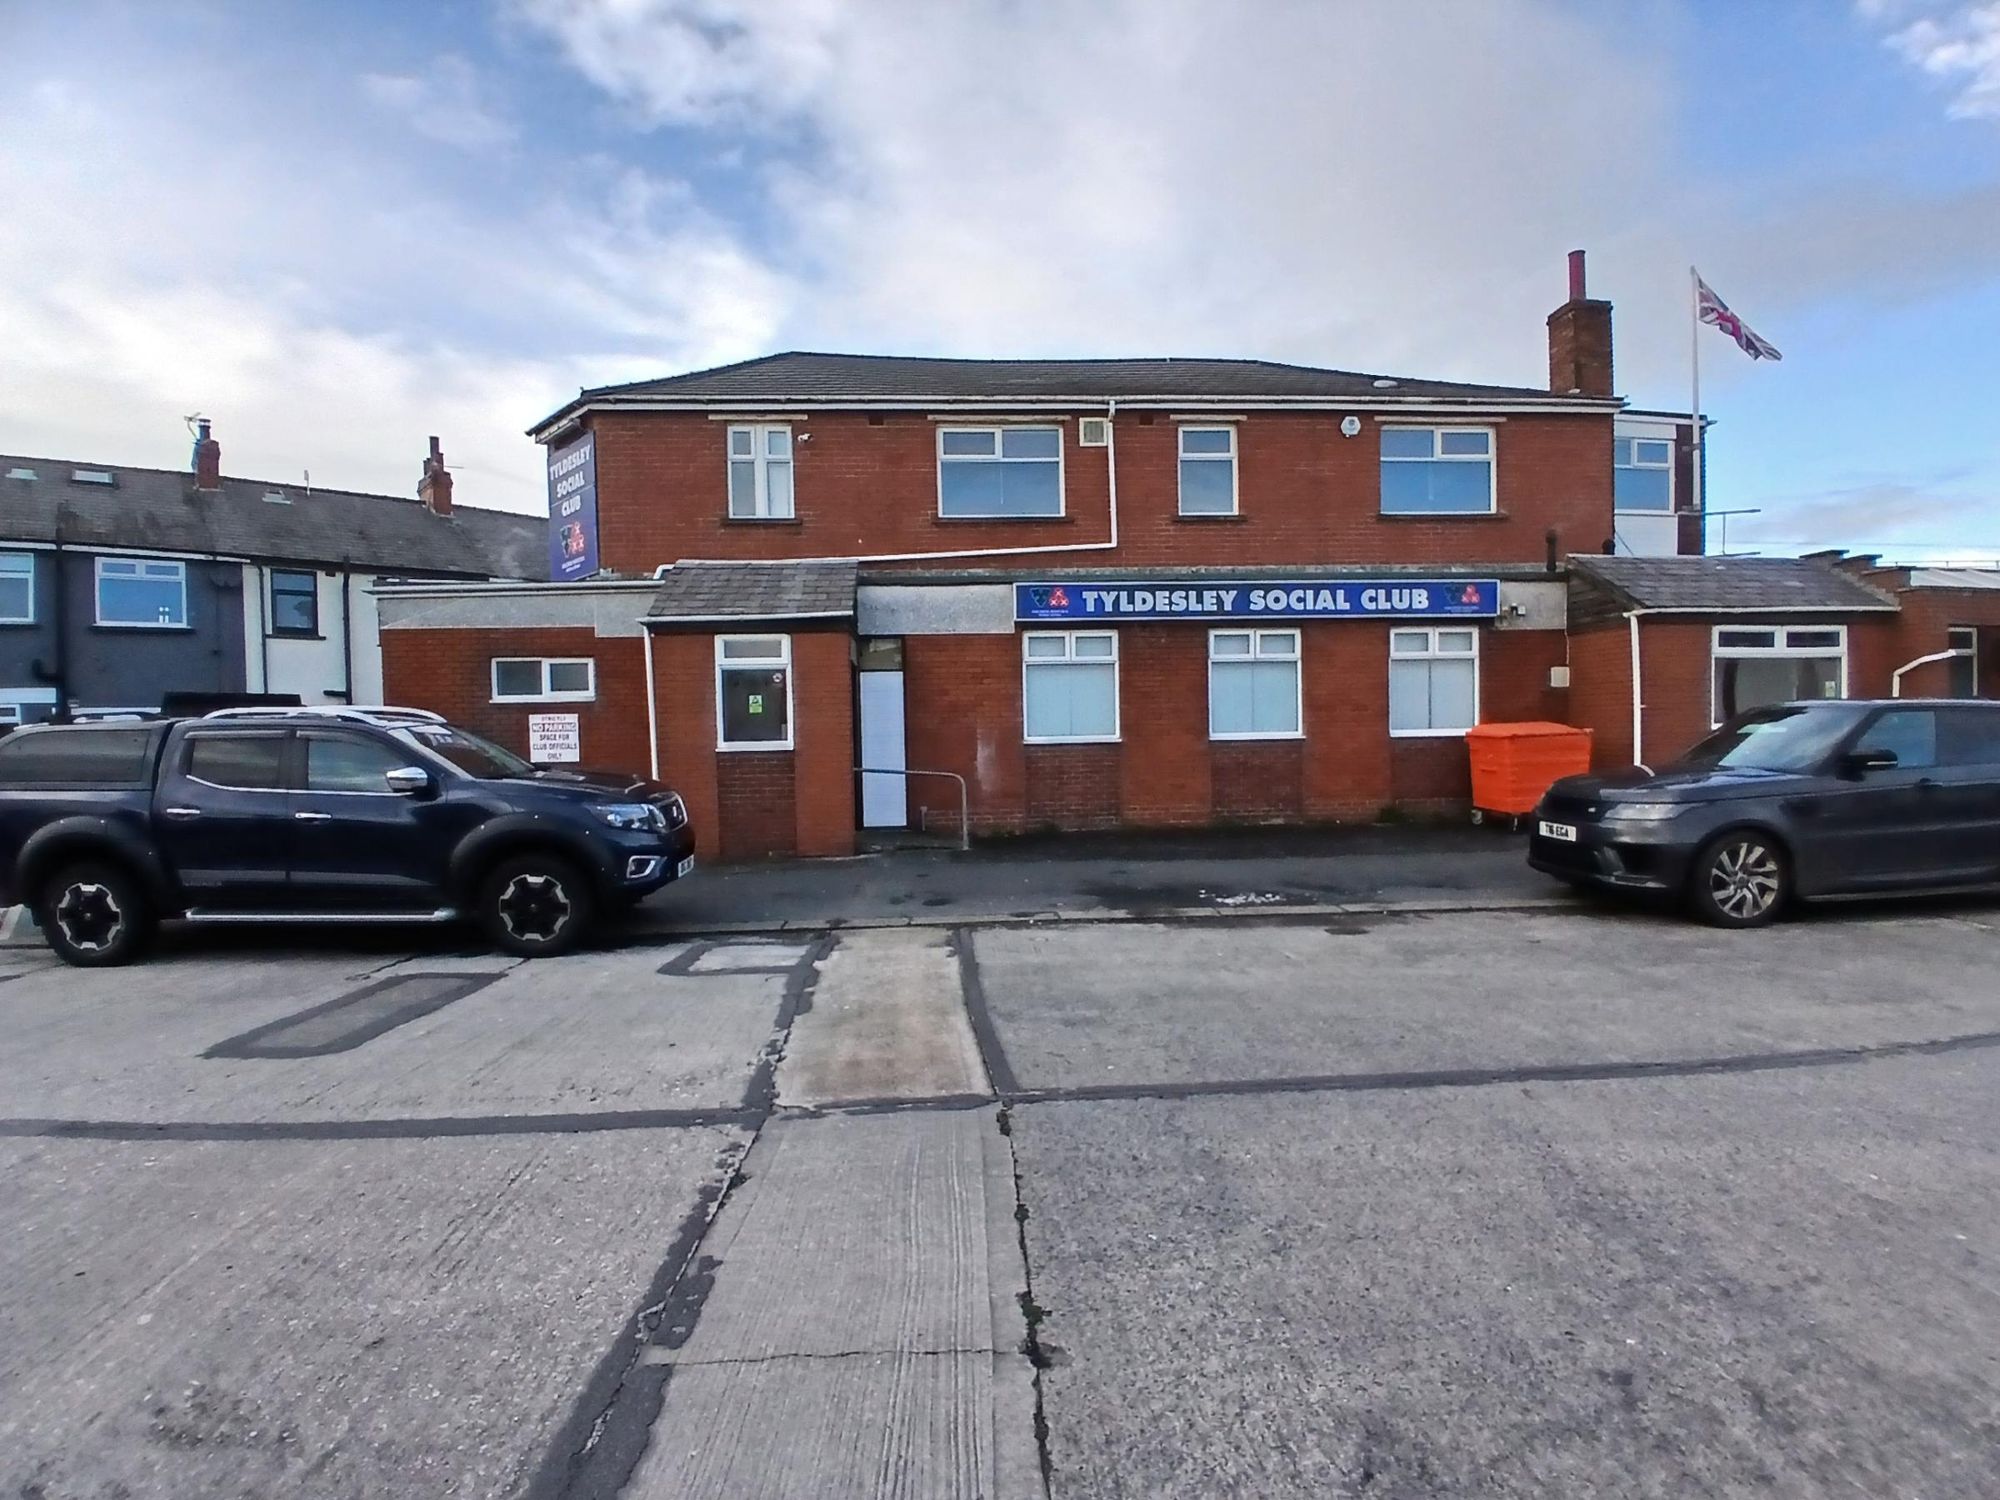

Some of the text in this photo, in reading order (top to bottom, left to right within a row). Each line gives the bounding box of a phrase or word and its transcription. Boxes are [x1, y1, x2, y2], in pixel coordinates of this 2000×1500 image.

[550, 445, 591, 480] TYLDESLEY
[556, 471, 585, 498] SOCIAL
[561, 494, 581, 517] CLUB
[1082, 589, 1430, 612] TYLDESLEY SOCIAL CLUB
[532, 723, 576, 731] NO PARKING
[547, 752, 562, 760] ONLY
